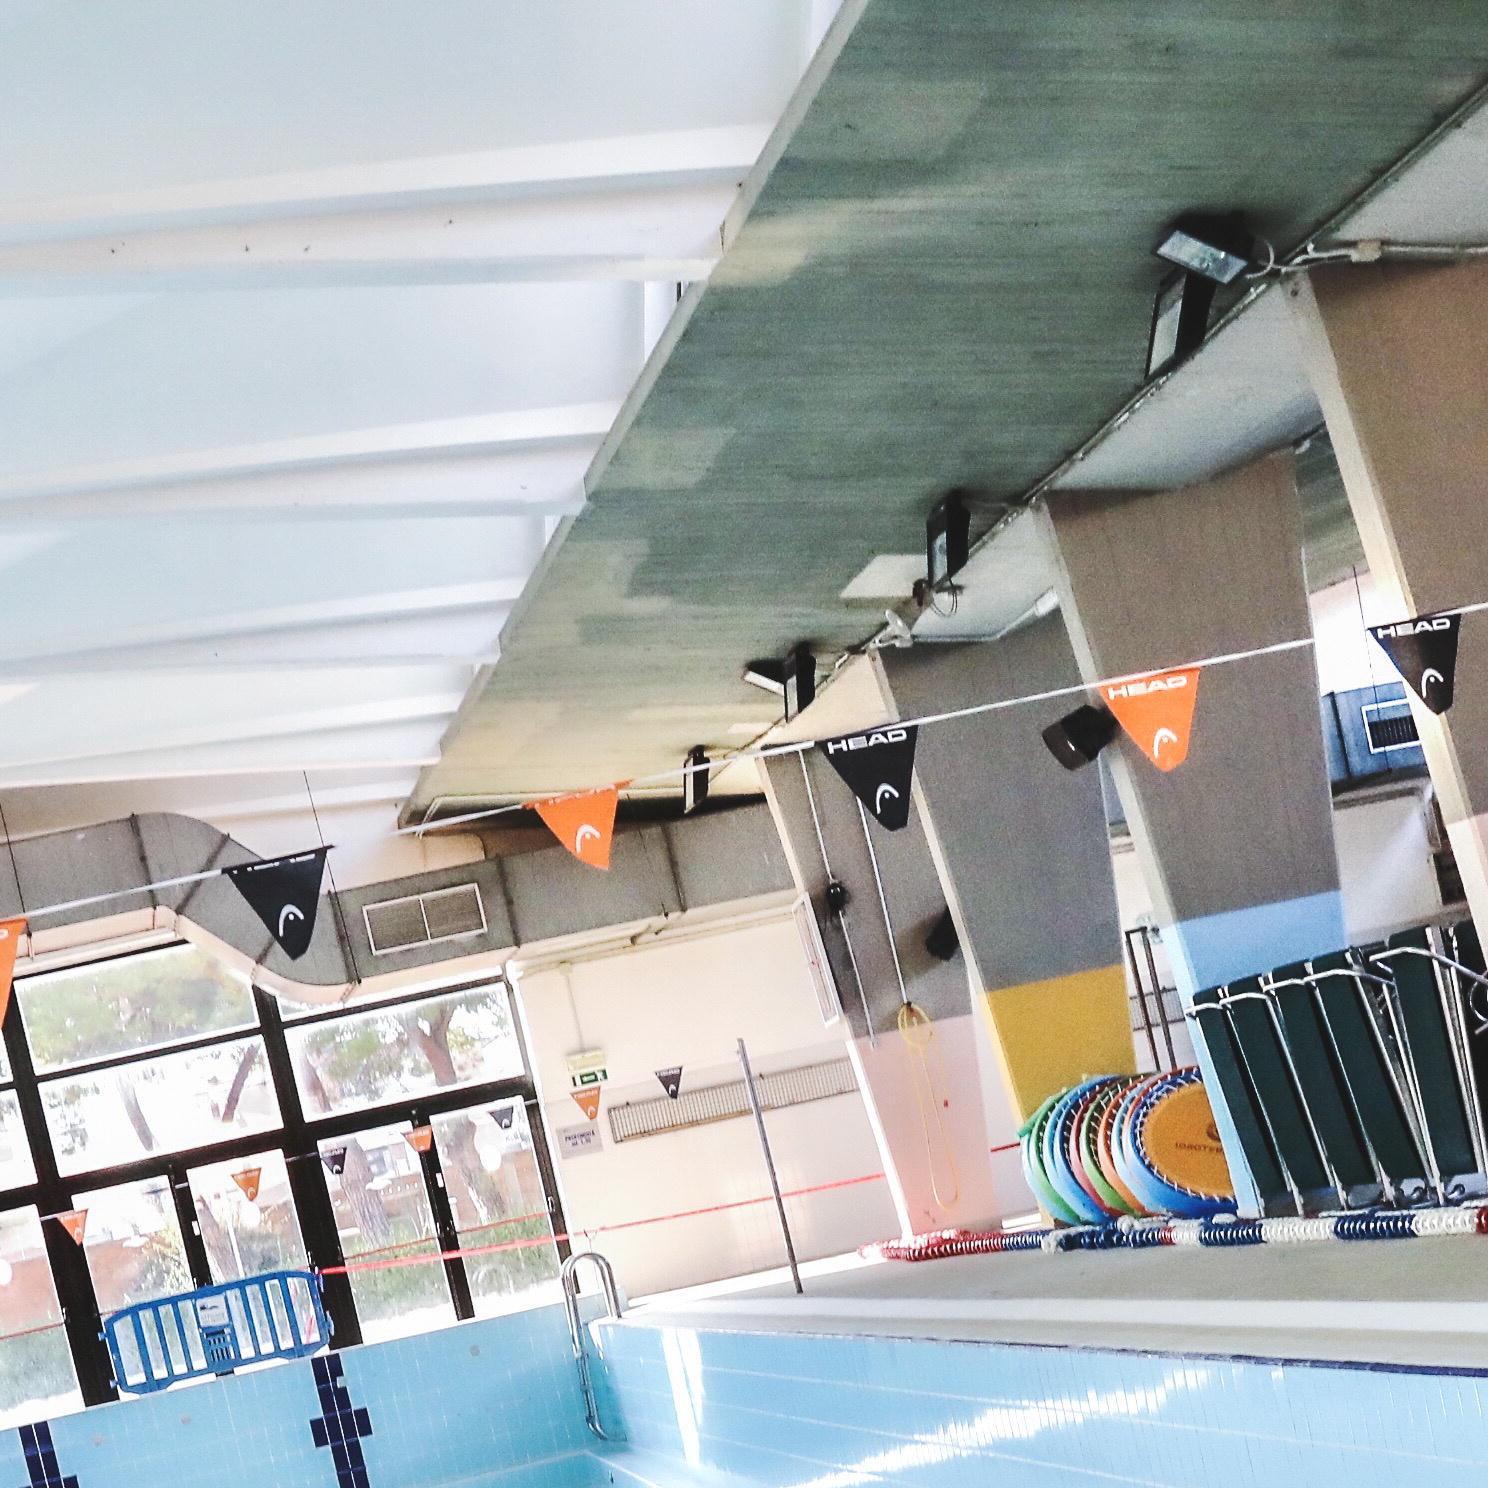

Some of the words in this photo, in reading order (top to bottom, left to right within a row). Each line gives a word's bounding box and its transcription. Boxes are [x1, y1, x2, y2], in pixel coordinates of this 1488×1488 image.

[1377, 617, 1452, 641] HEAD
[1107, 674, 1189, 701] HEAD
[827, 727, 909, 756] HEAD
